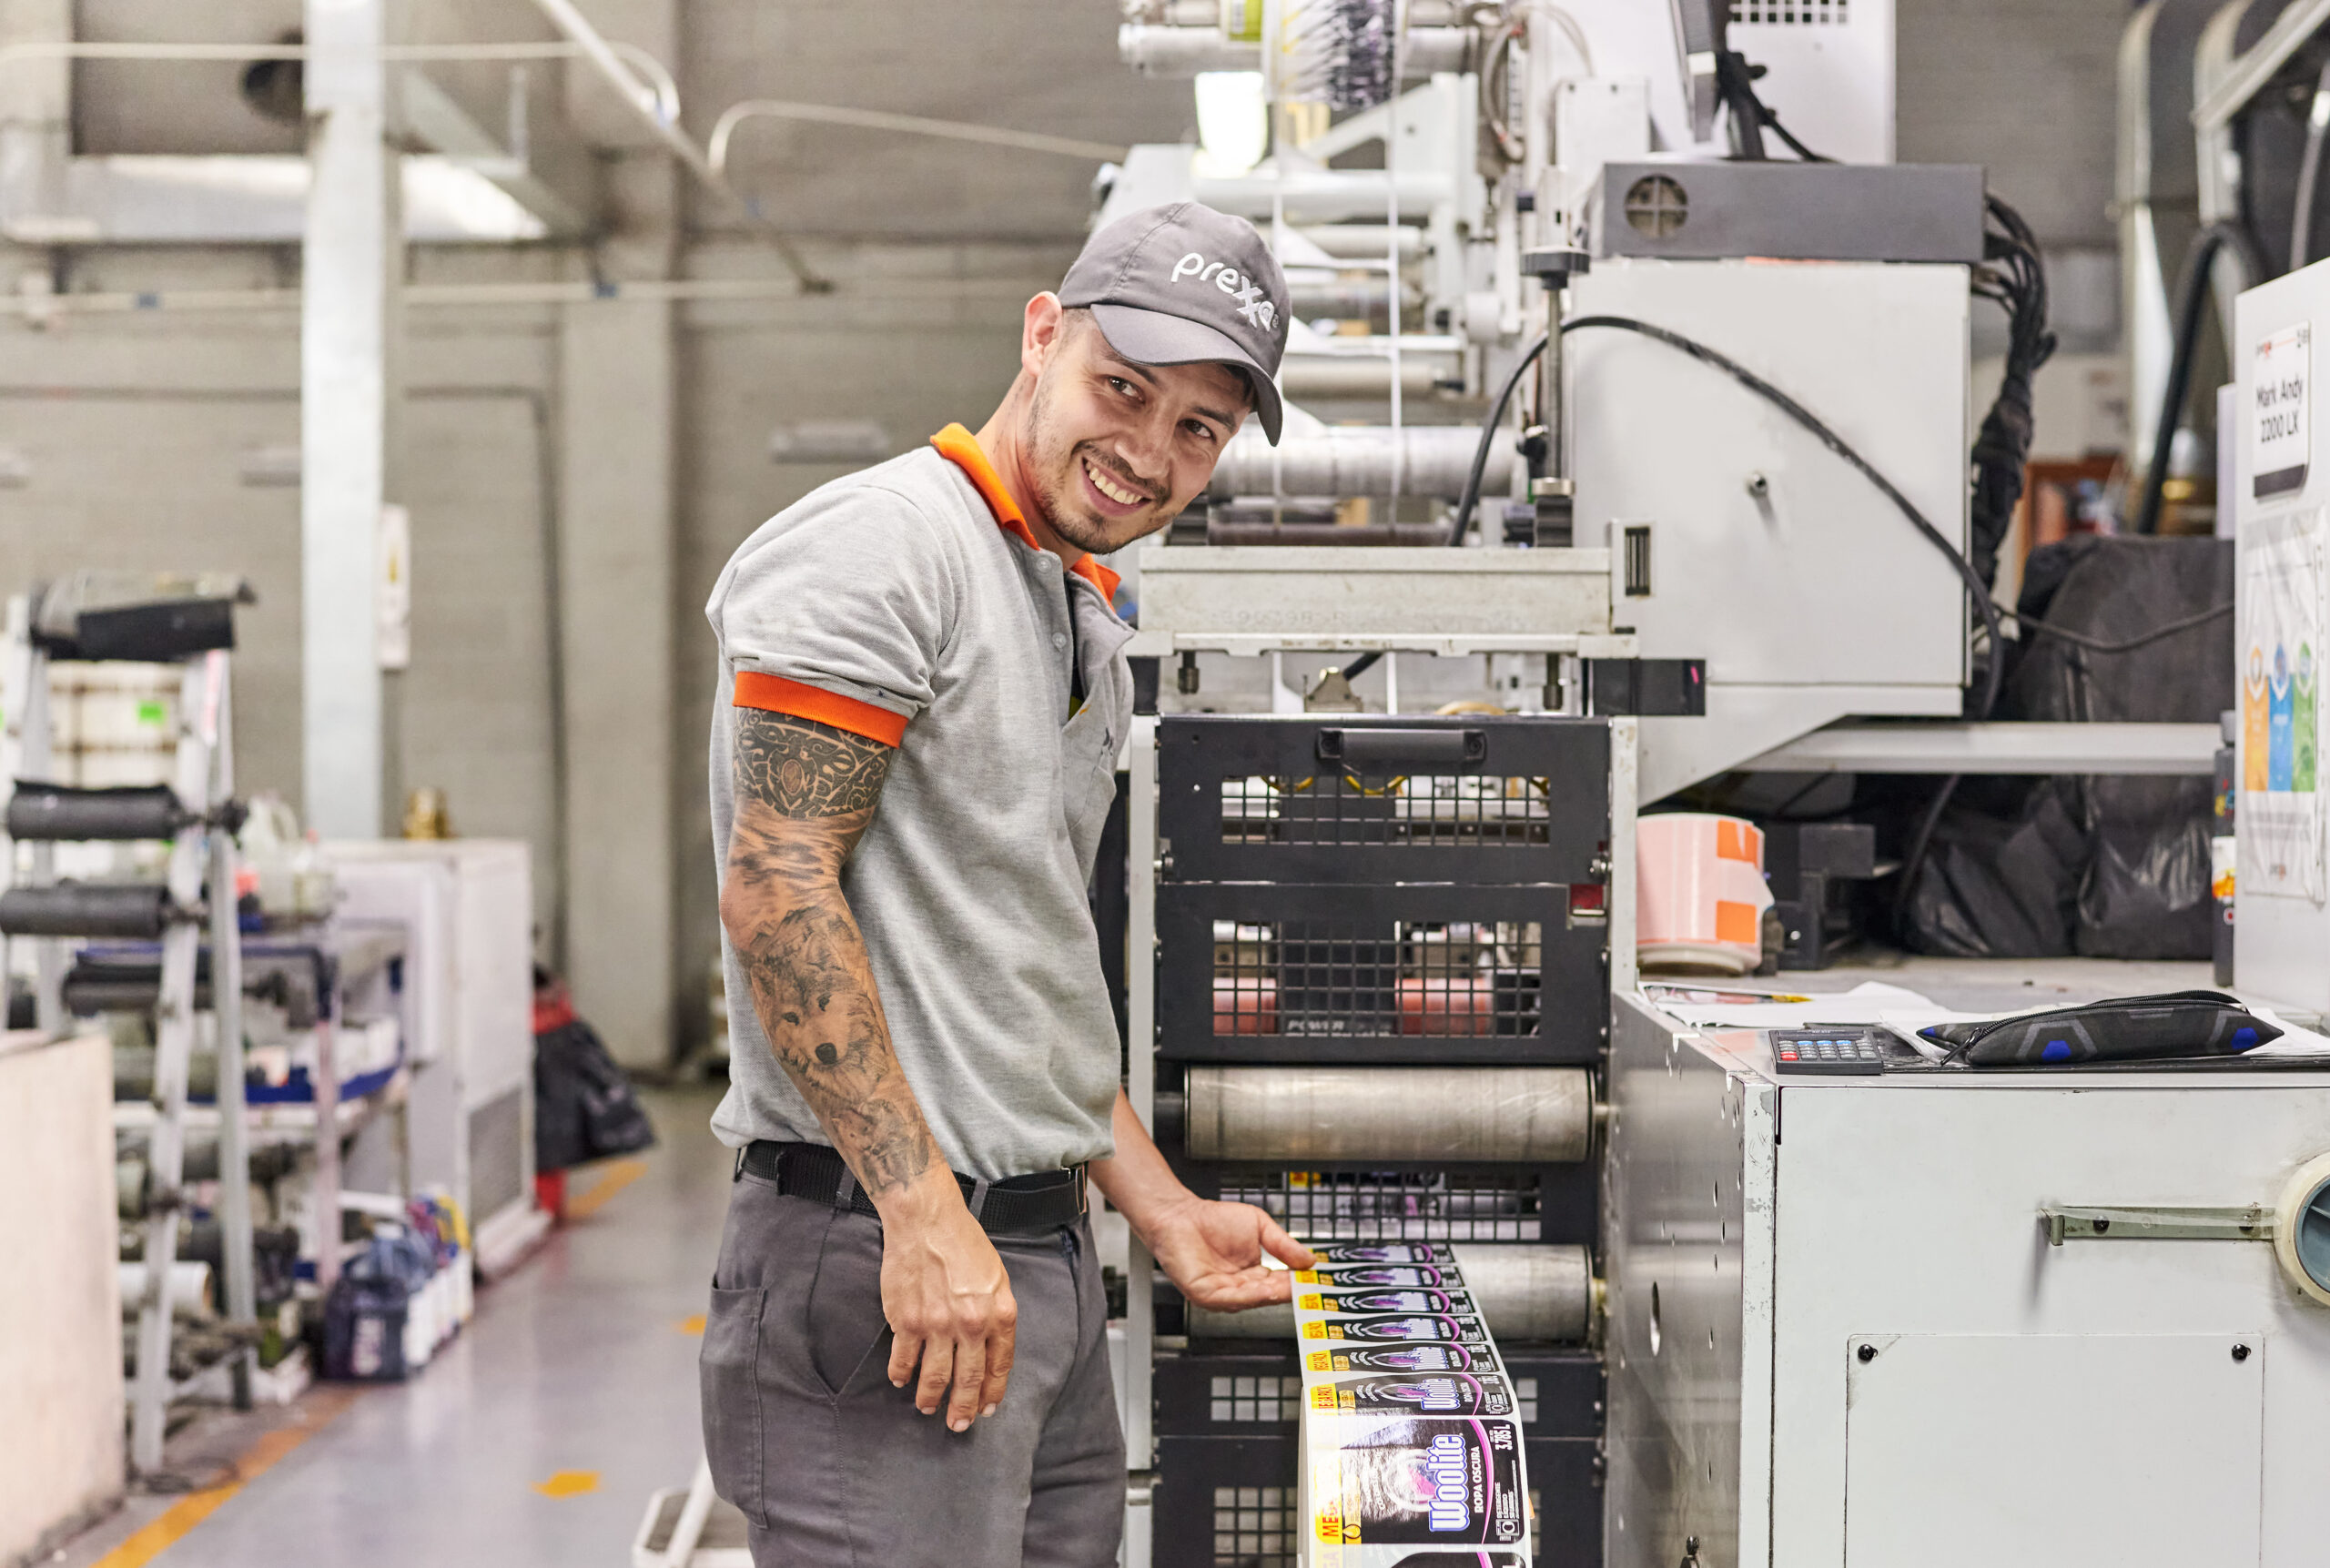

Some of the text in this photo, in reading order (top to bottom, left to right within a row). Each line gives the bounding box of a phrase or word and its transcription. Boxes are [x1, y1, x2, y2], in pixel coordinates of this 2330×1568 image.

[2256, 373, 2303, 410] Mark Andy
[2261, 410, 2299, 443] 2200 LX
[1494, 1430, 1513, 1451] 3.785
[1426, 1433, 1471, 1533] Woolite
[1471, 1446, 1484, 1513] ROPA OSCURA
